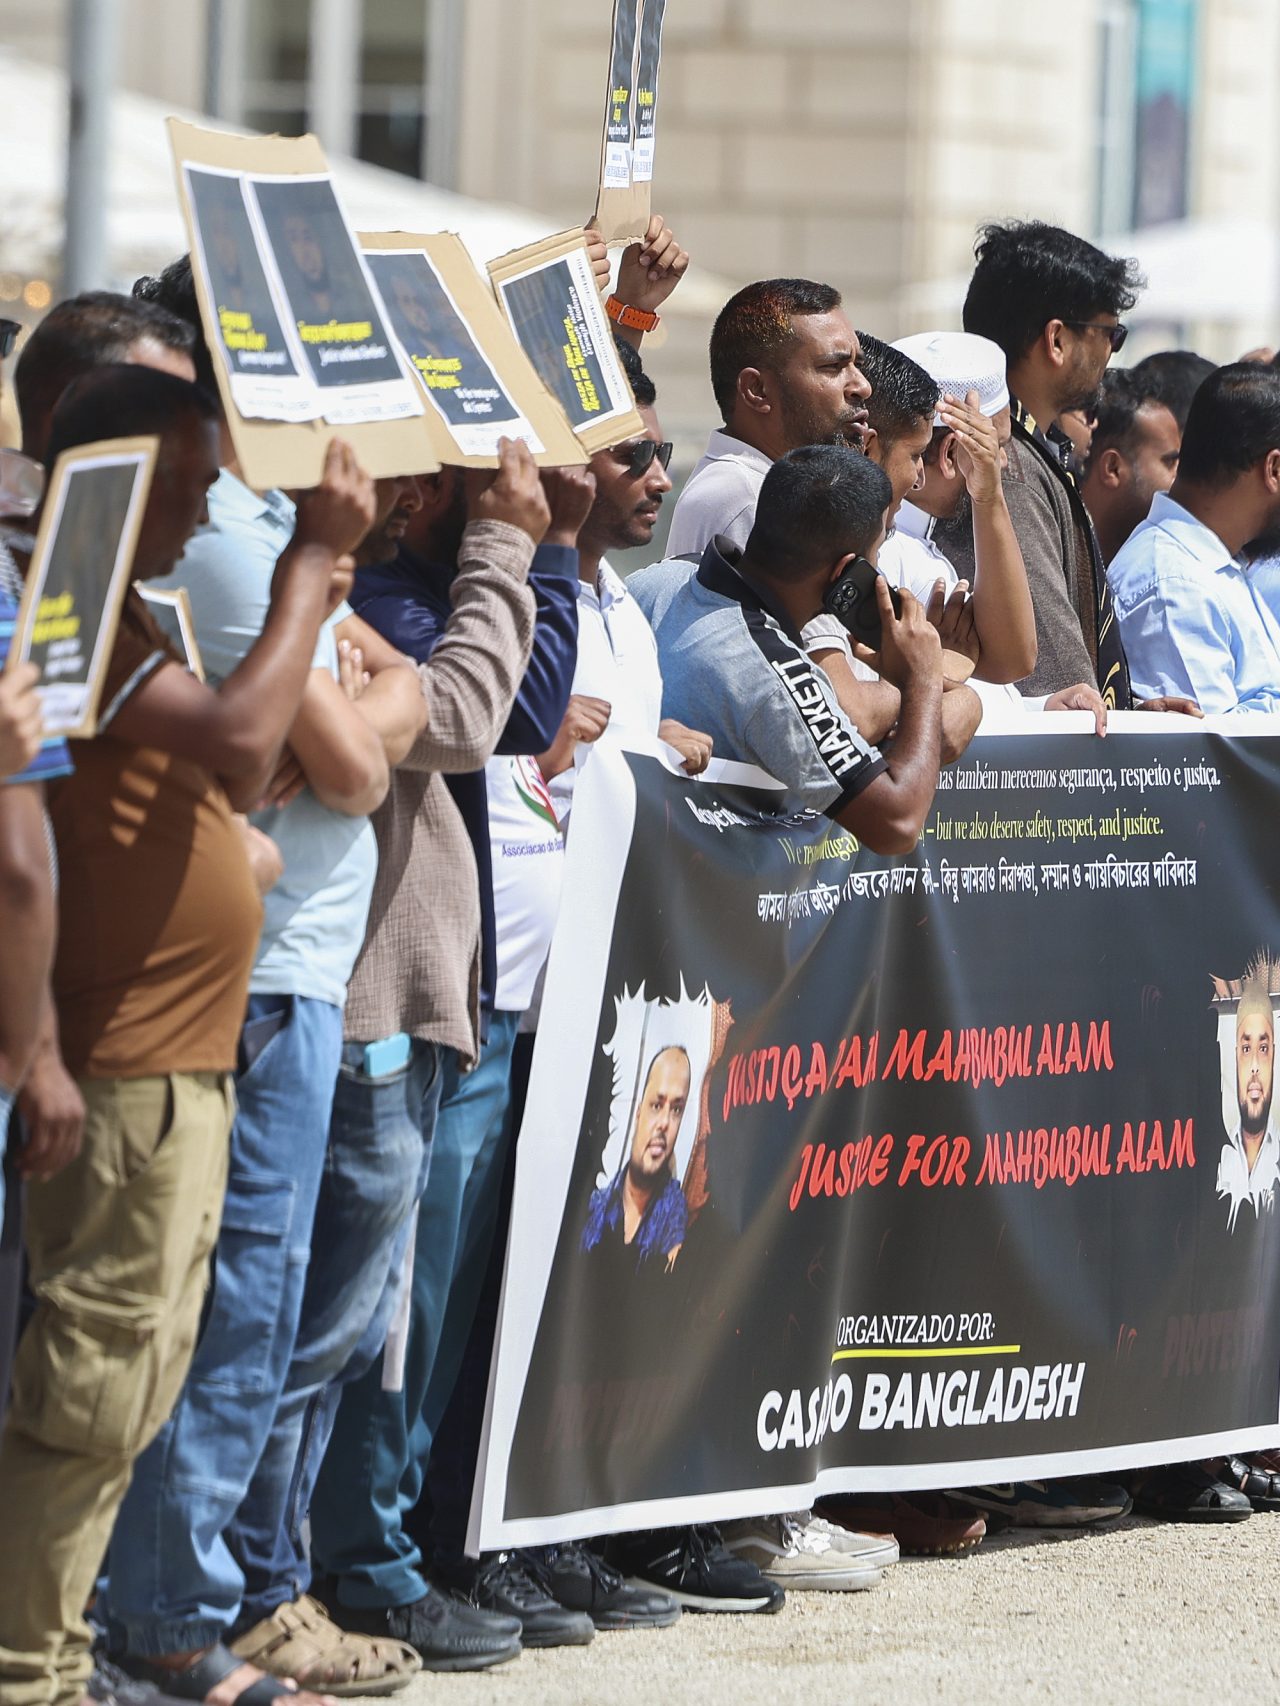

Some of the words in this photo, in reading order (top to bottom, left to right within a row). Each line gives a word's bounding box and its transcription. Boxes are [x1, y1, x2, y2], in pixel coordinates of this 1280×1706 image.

[956, 760, 998, 790] também
[1001, 767, 1057, 790] merecemos
[1058, 768, 1117, 794] segurança,
[1120, 758, 1171, 793] respeito
[1173, 767, 1182, 786] e
[1183, 757, 1221, 792] justiça.
[936, 811, 953, 840] but
[954, 820, 968, 840] we
[969, 811, 988, 839] also
[990, 811, 1024, 839] deserve
[1025, 810, 1056, 844] safety,
[1057, 814, 1097, 844] respect,
[1099, 808, 1121, 836] and
[1122, 808, 1164, 841] justice.
[940, 858, 960, 904] কিন্তু
[961, 864, 996, 895] আমরাও
[1041, 861, 1070, 891] সম্মান
[1072, 864, 1081, 888] ও
[1084, 853, 1150, 890] ন্যায়বিচারের
[1152, 852, 1197, 888] দাবিদার
[723, 1042, 827, 1123] JUSTIÇA
[882, 1025, 1033, 1089] MAHBUBUL
[1036, 1020, 1114, 1076] ALAM
[897, 1134, 971, 1187] FOR
[975, 1124, 1112, 1190] MAHBUBUL
[1116, 1118, 1196, 1174] ALAM
[836, 1313, 954, 1346] ORGANIZADO
[956, 1312, 996, 1341] POR:
[858, 1362, 1086, 1431] BANGLADESH
